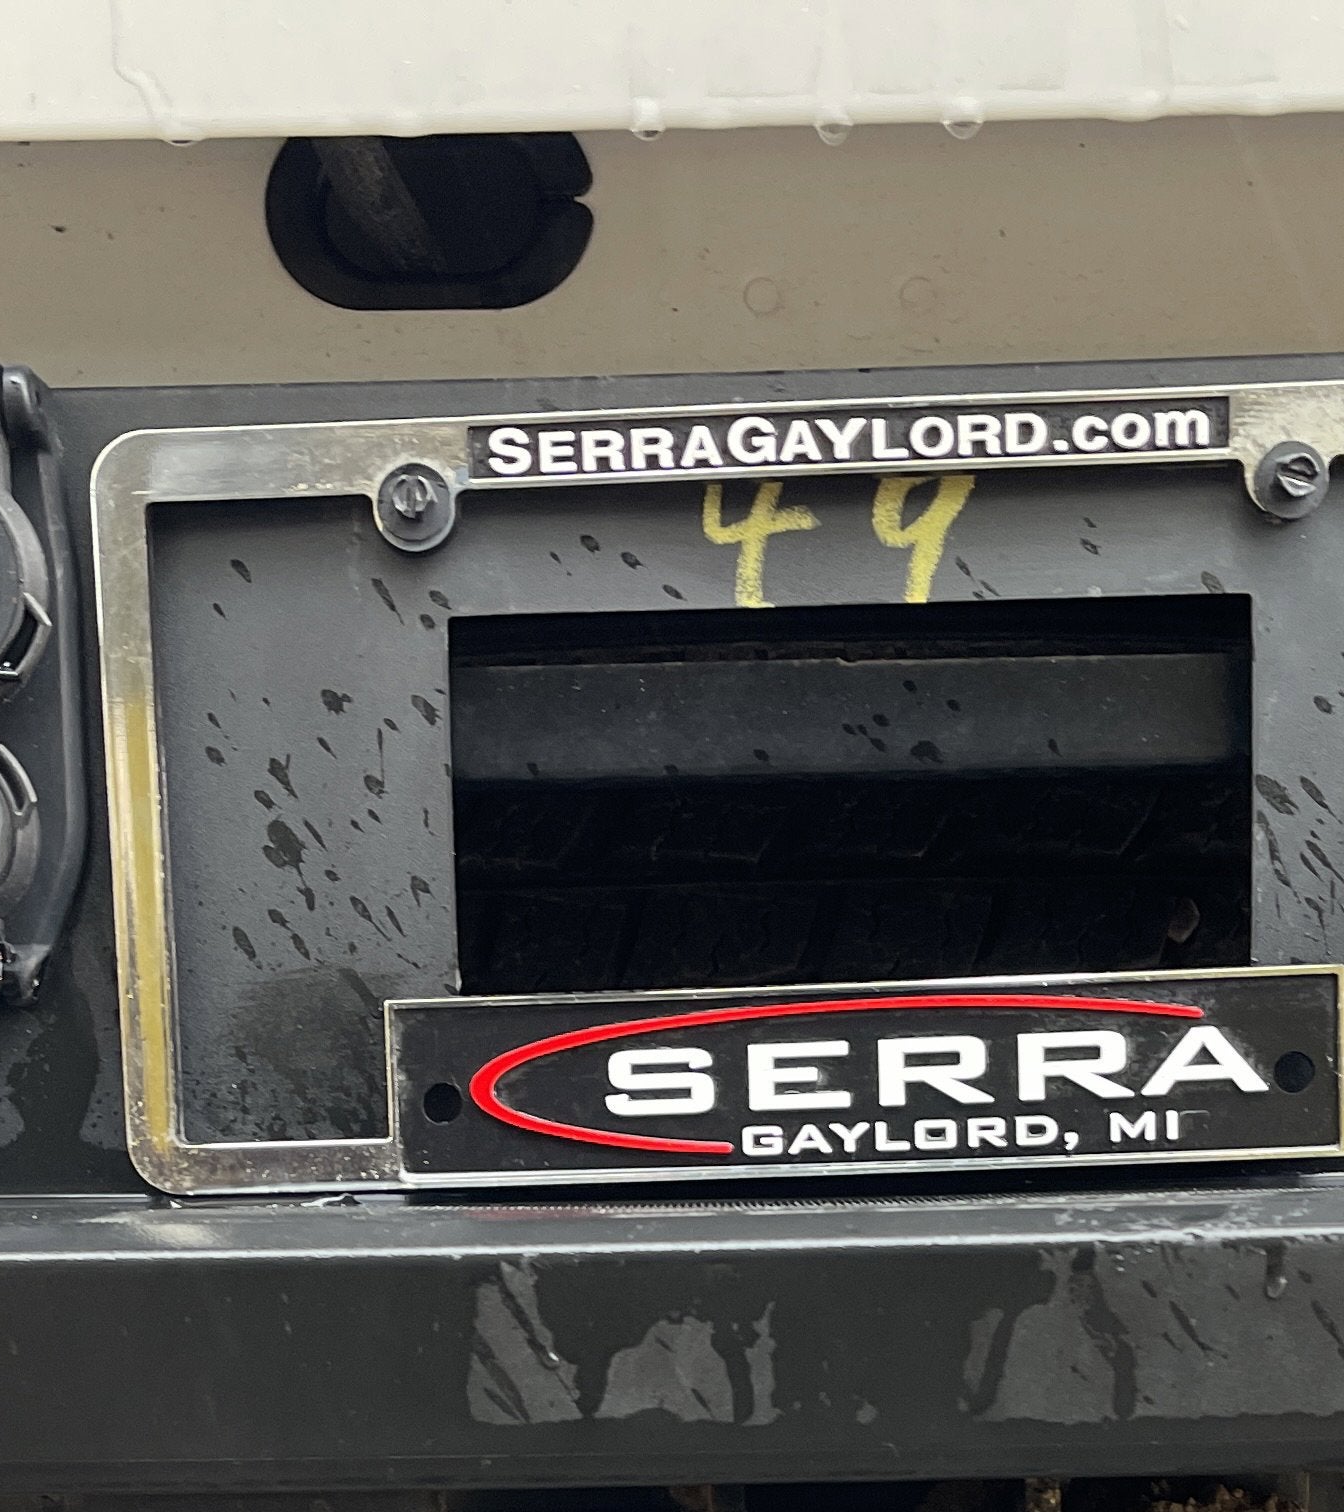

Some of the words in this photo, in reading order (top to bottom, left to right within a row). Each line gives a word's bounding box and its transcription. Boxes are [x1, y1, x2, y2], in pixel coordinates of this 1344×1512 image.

[487, 408, 1212, 476] SERRAGAYLORD.com
[604, 1024, 1271, 1117] SERRA
[740, 1115, 1080, 1157] GAYLORD,
[1109, 1109, 1181, 1143] MI
